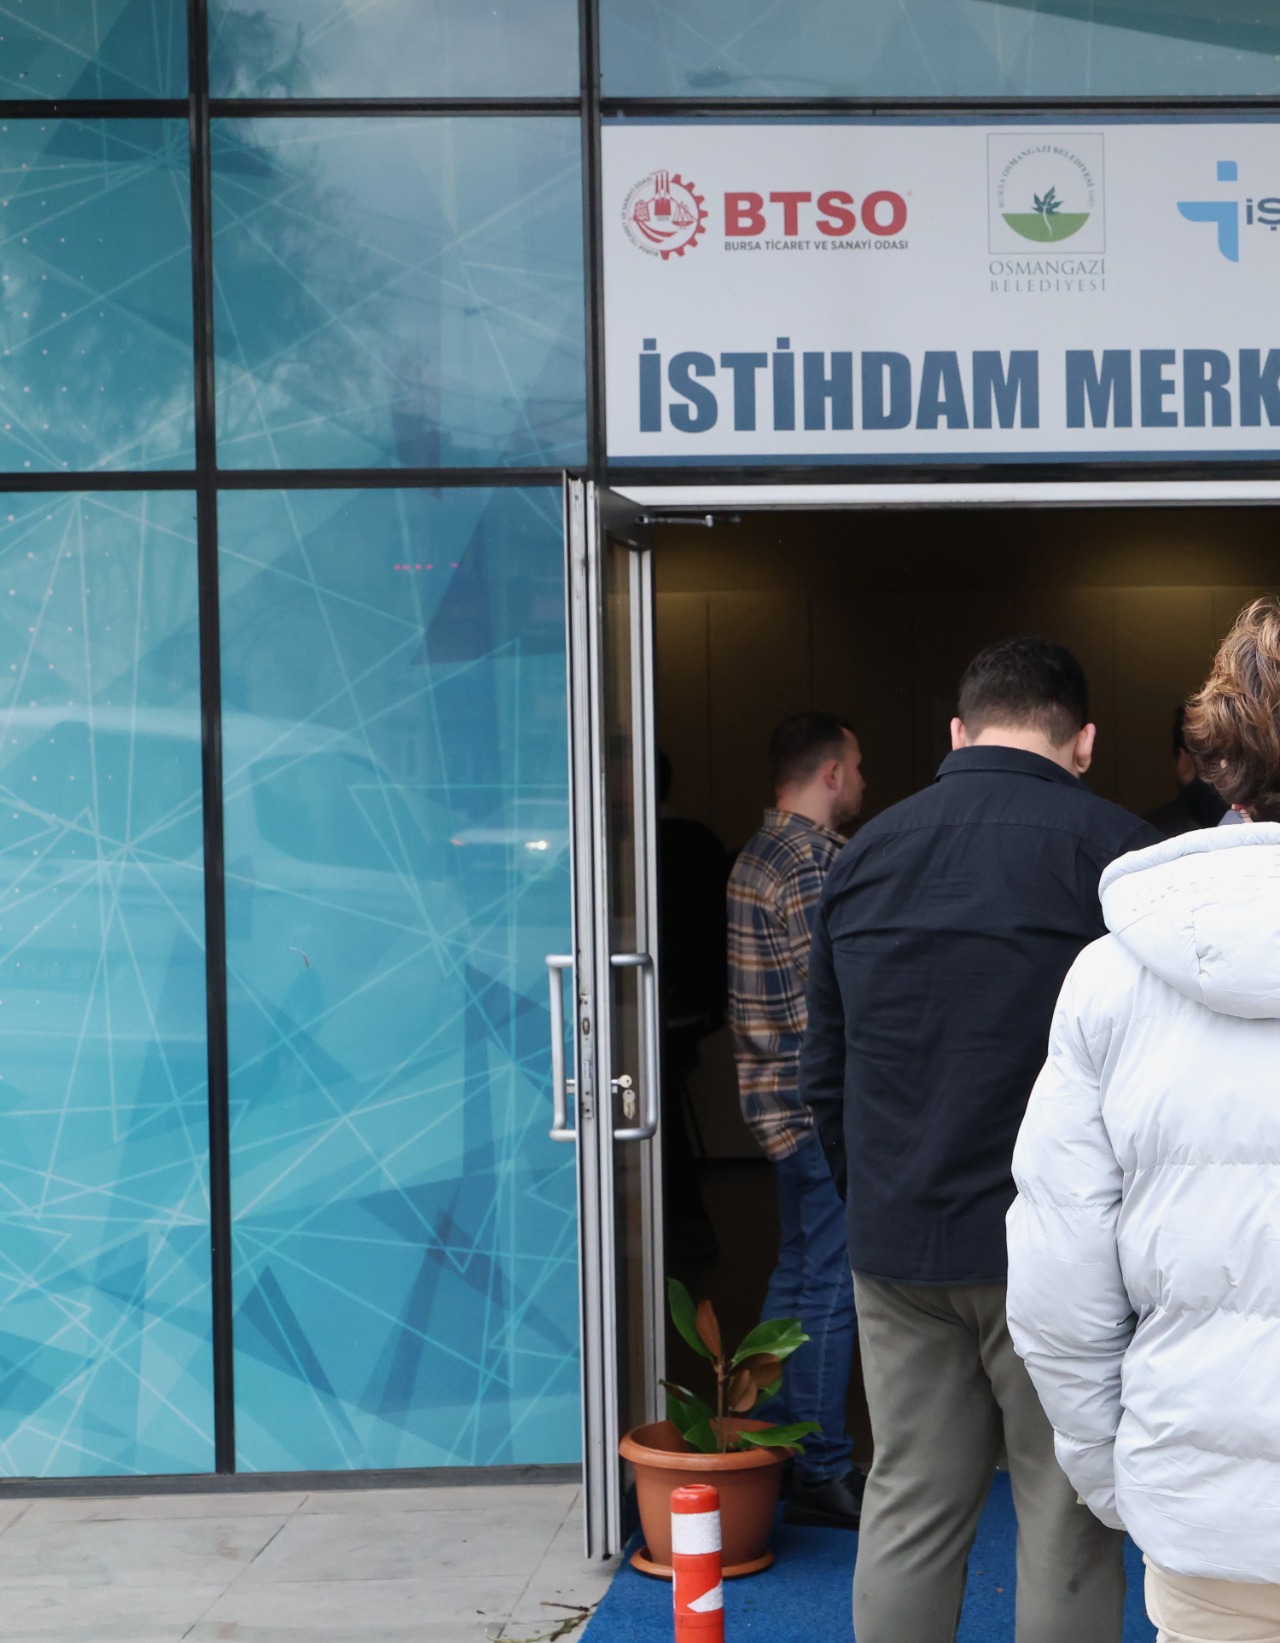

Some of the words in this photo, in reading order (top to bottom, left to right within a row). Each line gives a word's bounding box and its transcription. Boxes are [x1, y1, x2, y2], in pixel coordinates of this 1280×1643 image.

[724, 190, 908, 236] BTSO
[724, 240, 761, 251] BURSA
[765, 238, 811, 251] TİCARET
[814, 240, 828, 250] VE
[831, 239, 872, 250] SANAYİ
[874, 240, 908, 250] ODASI
[988, 258, 1106, 276] OSMANGAZİ
[990, 277, 1106, 293] BELEDİYESİ
[638, 337, 1040, 434] İSTİHDAM
